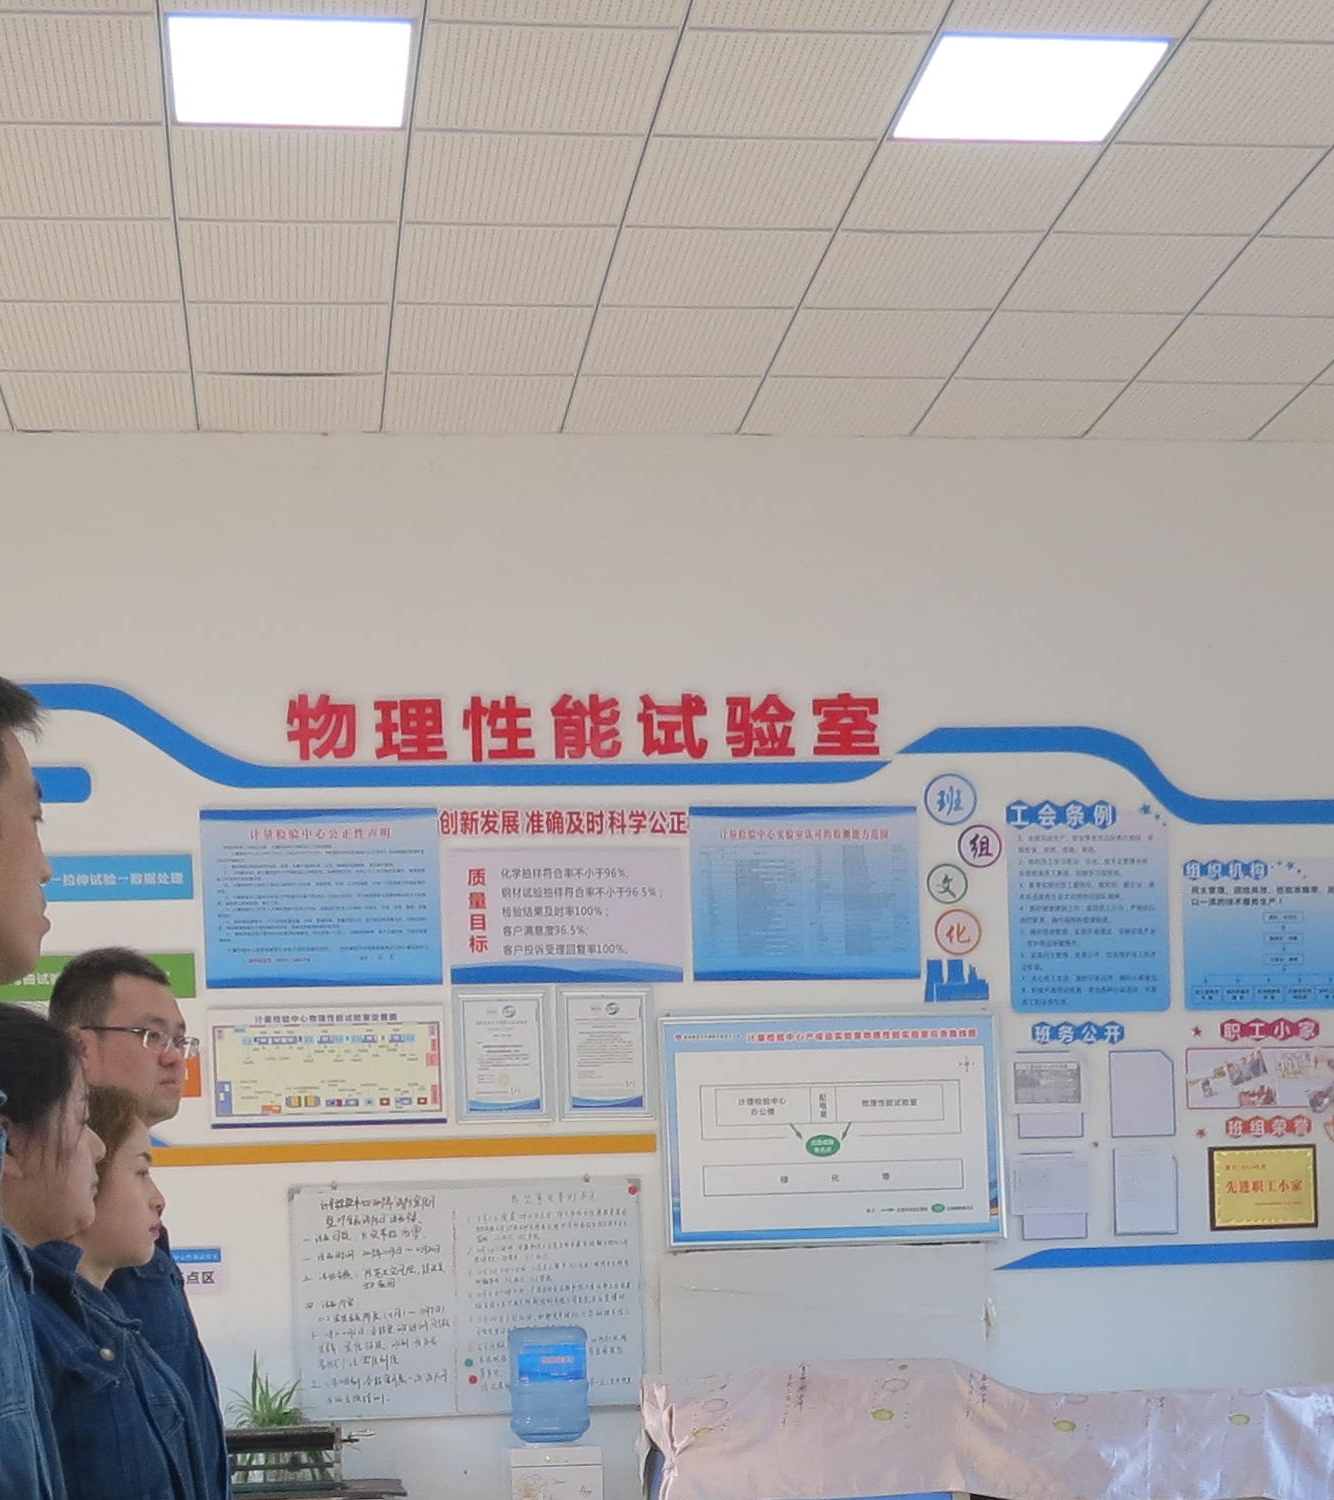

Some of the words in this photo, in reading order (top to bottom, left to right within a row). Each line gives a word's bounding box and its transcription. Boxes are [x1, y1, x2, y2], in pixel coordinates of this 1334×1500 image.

[286, 693, 881, 762] 物理性能试验室
[937, 785, 964, 816] 班
[440, 810, 520, 835] 创新发展
[525, 810, 604, 835] 准确及时
[609, 809, 688, 835] 科学公正
[1010, 804, 1113, 827] 工会条例
[250, 828, 392, 840] 计量检验中心公正性声明
[969, 833, 993, 859] 组
[1186, 861, 1266, 878] 组织机构
[936, 874, 957, 899] 文
[468, 868, 489, 954] 质量目标
[946, 923, 971, 944] 化
[1034, 1024, 1121, 1042] 班务公开
[1223, 1021, 1316, 1039] 职工小家
[1227, 1118, 1310, 1136] 班组荣誉
[1226, 1179, 1303, 1194] 先进职工小家
[181, 1271, 216, 1285] 点区
